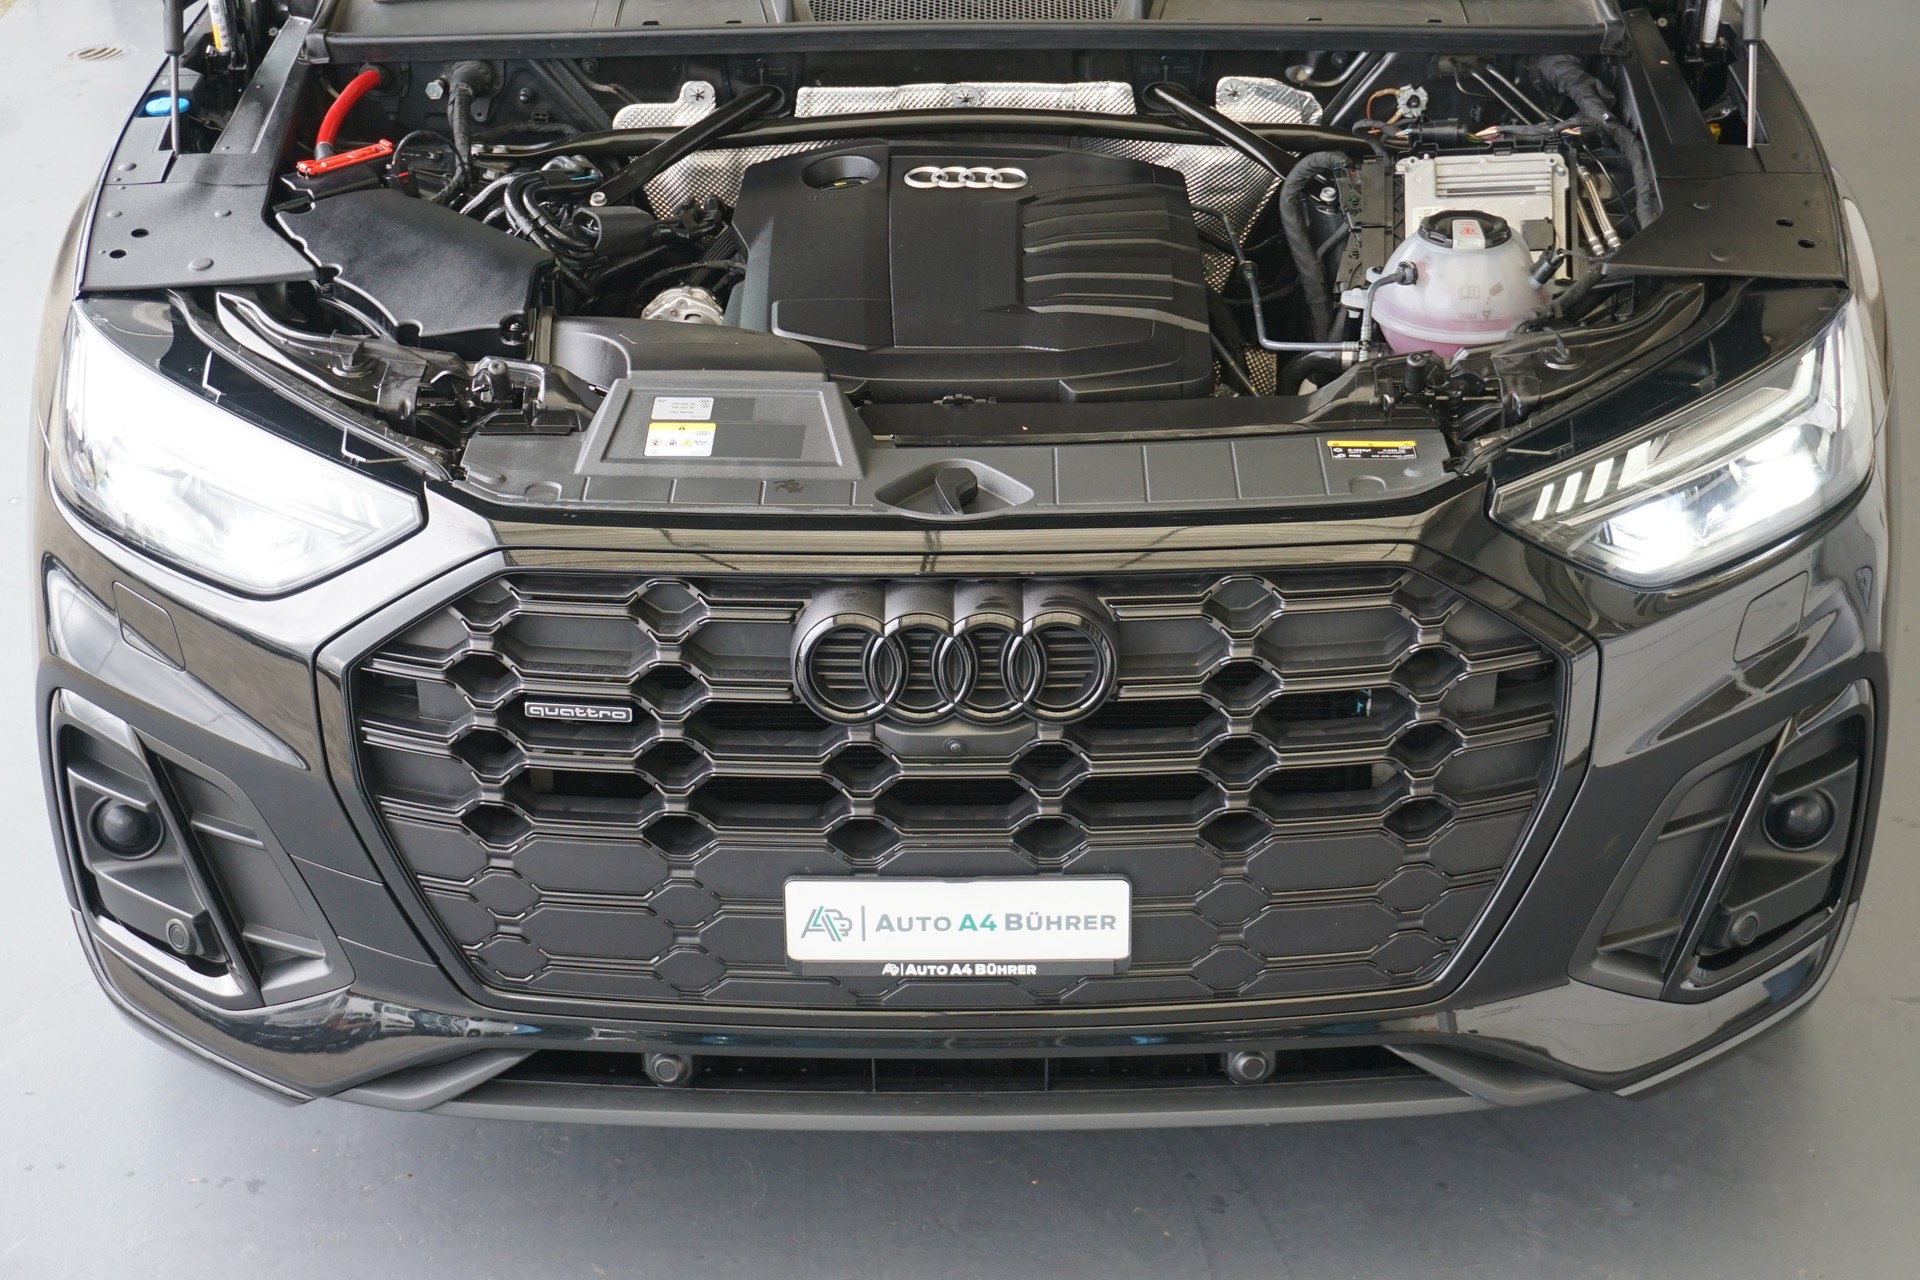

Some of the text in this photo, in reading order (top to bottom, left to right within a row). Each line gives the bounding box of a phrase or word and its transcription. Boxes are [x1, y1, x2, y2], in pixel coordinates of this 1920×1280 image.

[1458, 312, 1478, 320] max
[530, 706, 627, 719] quattro
[875, 911, 1117, 932] AUTO A4 BÜHRER
[905, 962, 1037, 976] AUTO A4 BÜHRER
